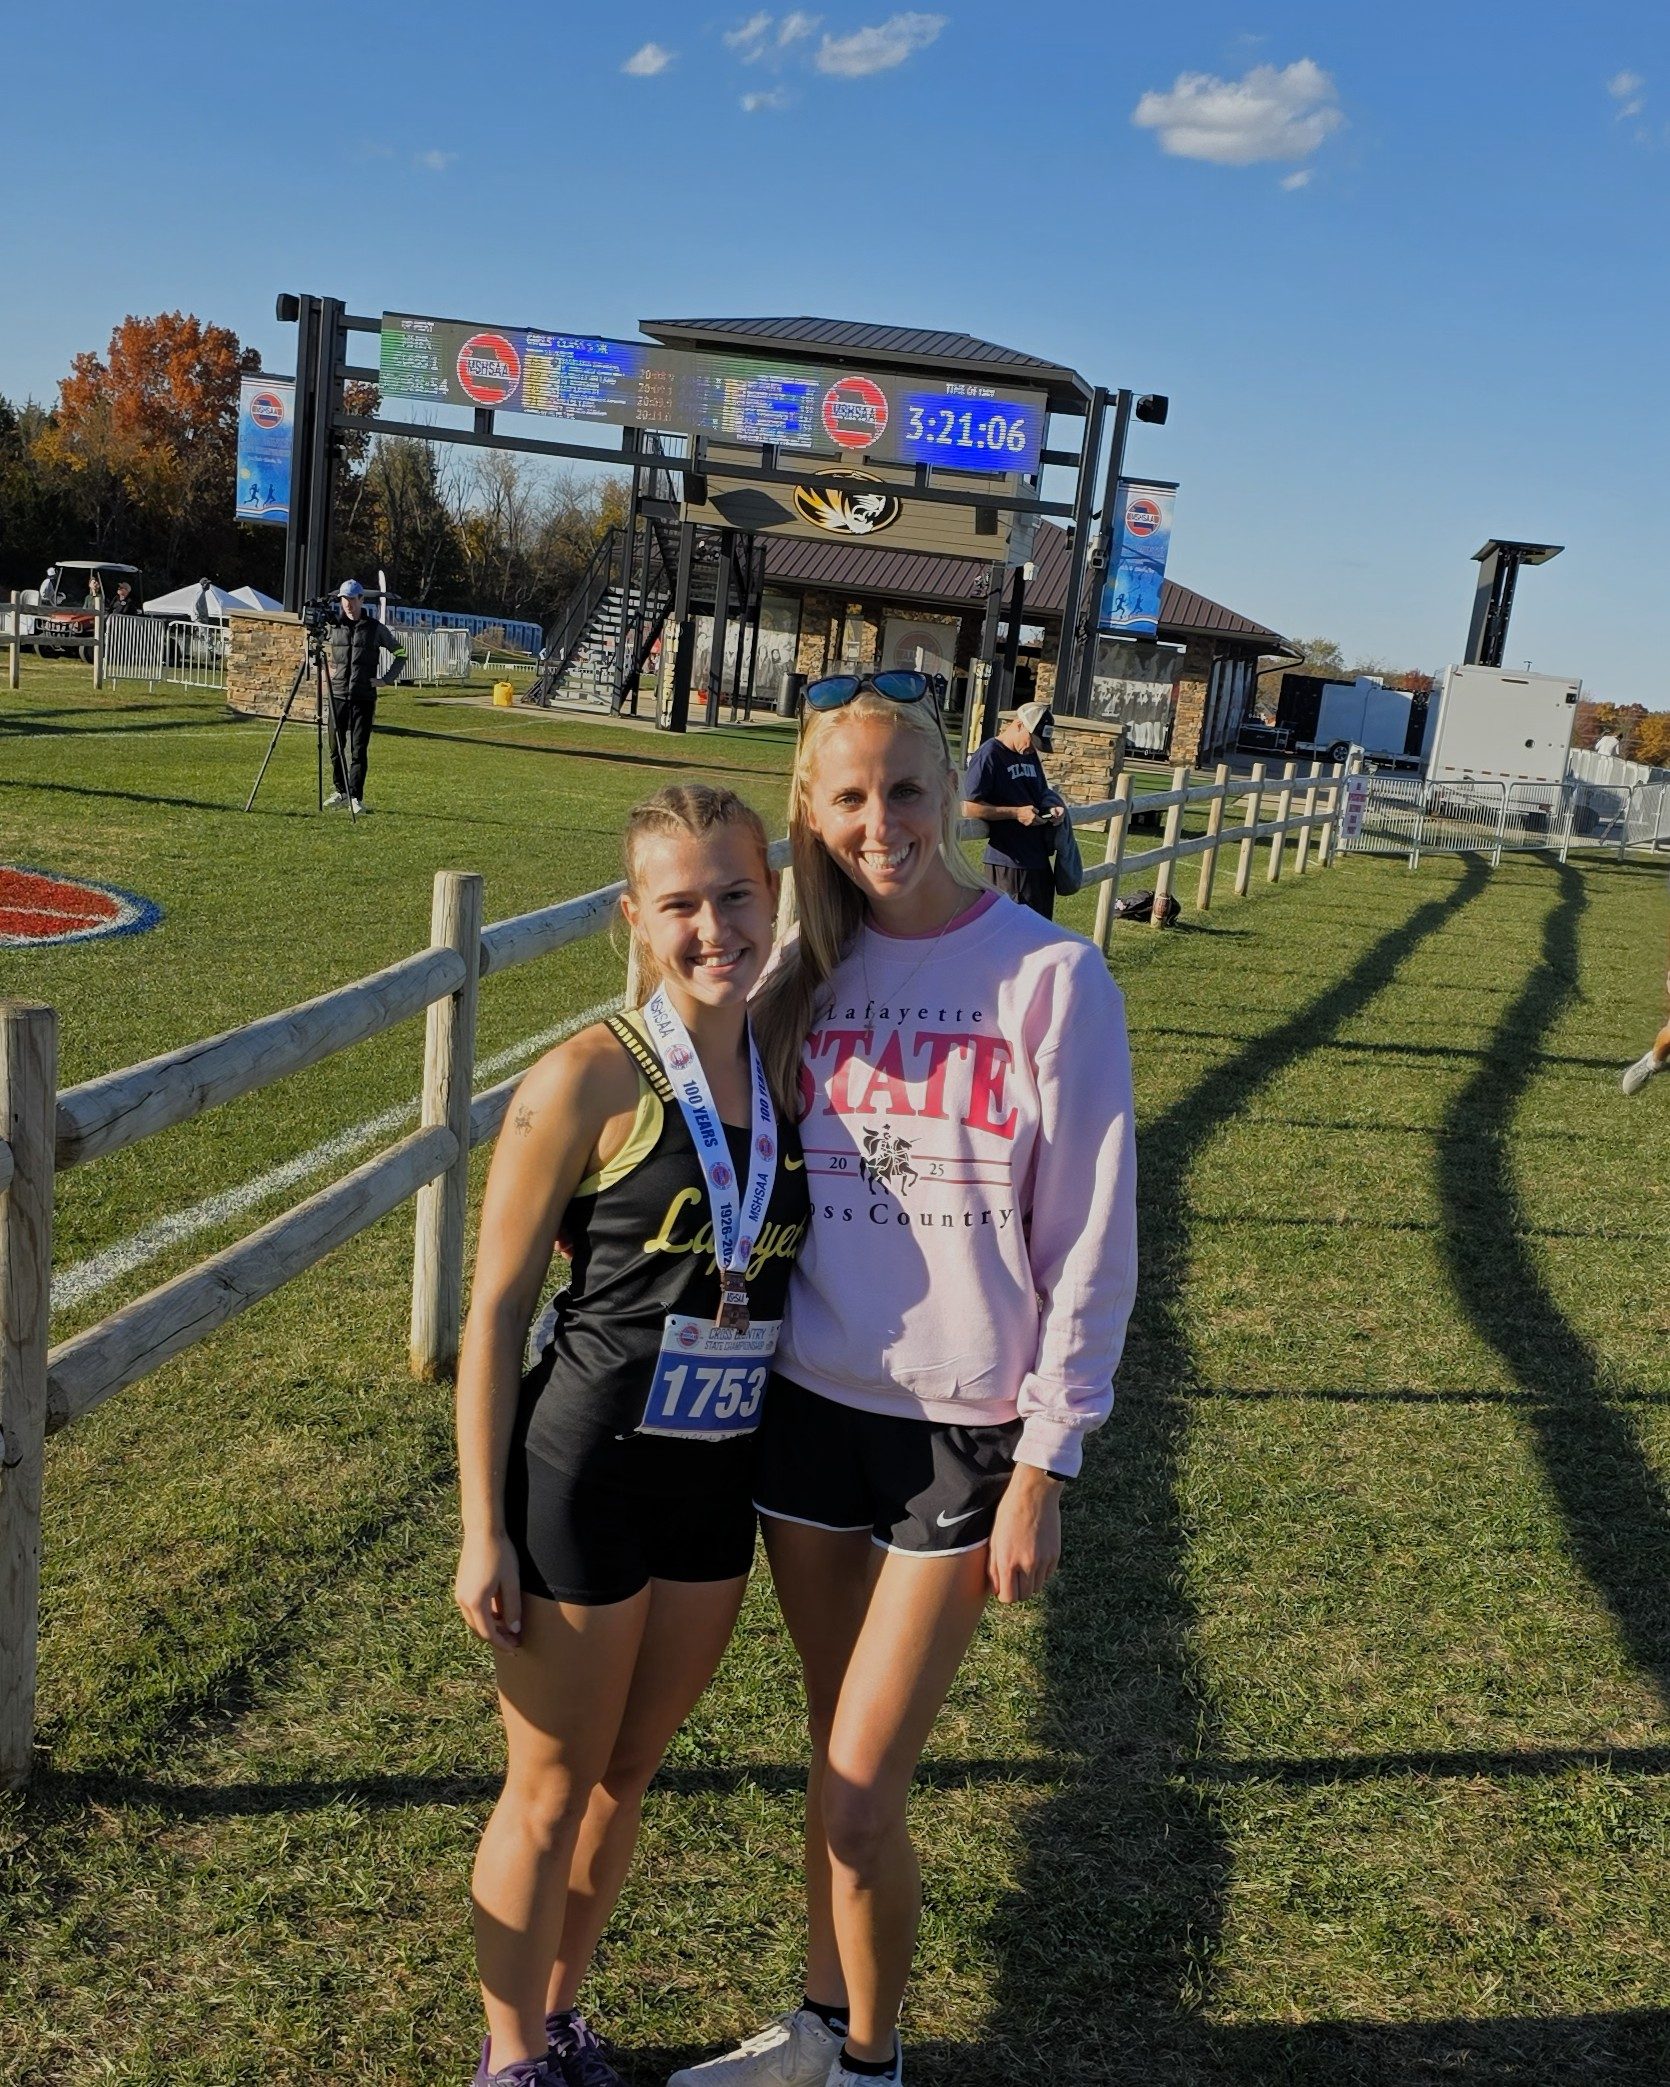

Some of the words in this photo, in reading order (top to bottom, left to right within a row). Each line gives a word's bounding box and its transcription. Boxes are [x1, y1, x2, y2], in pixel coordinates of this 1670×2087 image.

[905, 405, 1026, 453] 3:21:06
[827, 1000, 983, 1026] Lafayette
[683, 1080, 703, 1104] 100
[693, 1106, 718, 1148] YEARS
[760, 1098, 771, 1122] 100
[829, 1156, 847, 1170] 20
[929, 1162, 945, 1177] 25
[748, 1172, 768, 1222] MSHSAA
[869, 1203, 1014, 1228] Country
[720, 1202, 733, 1268] 1926-202
[704, 1341, 723, 1351] STATE
[662, 1364, 767, 1419] 1753
